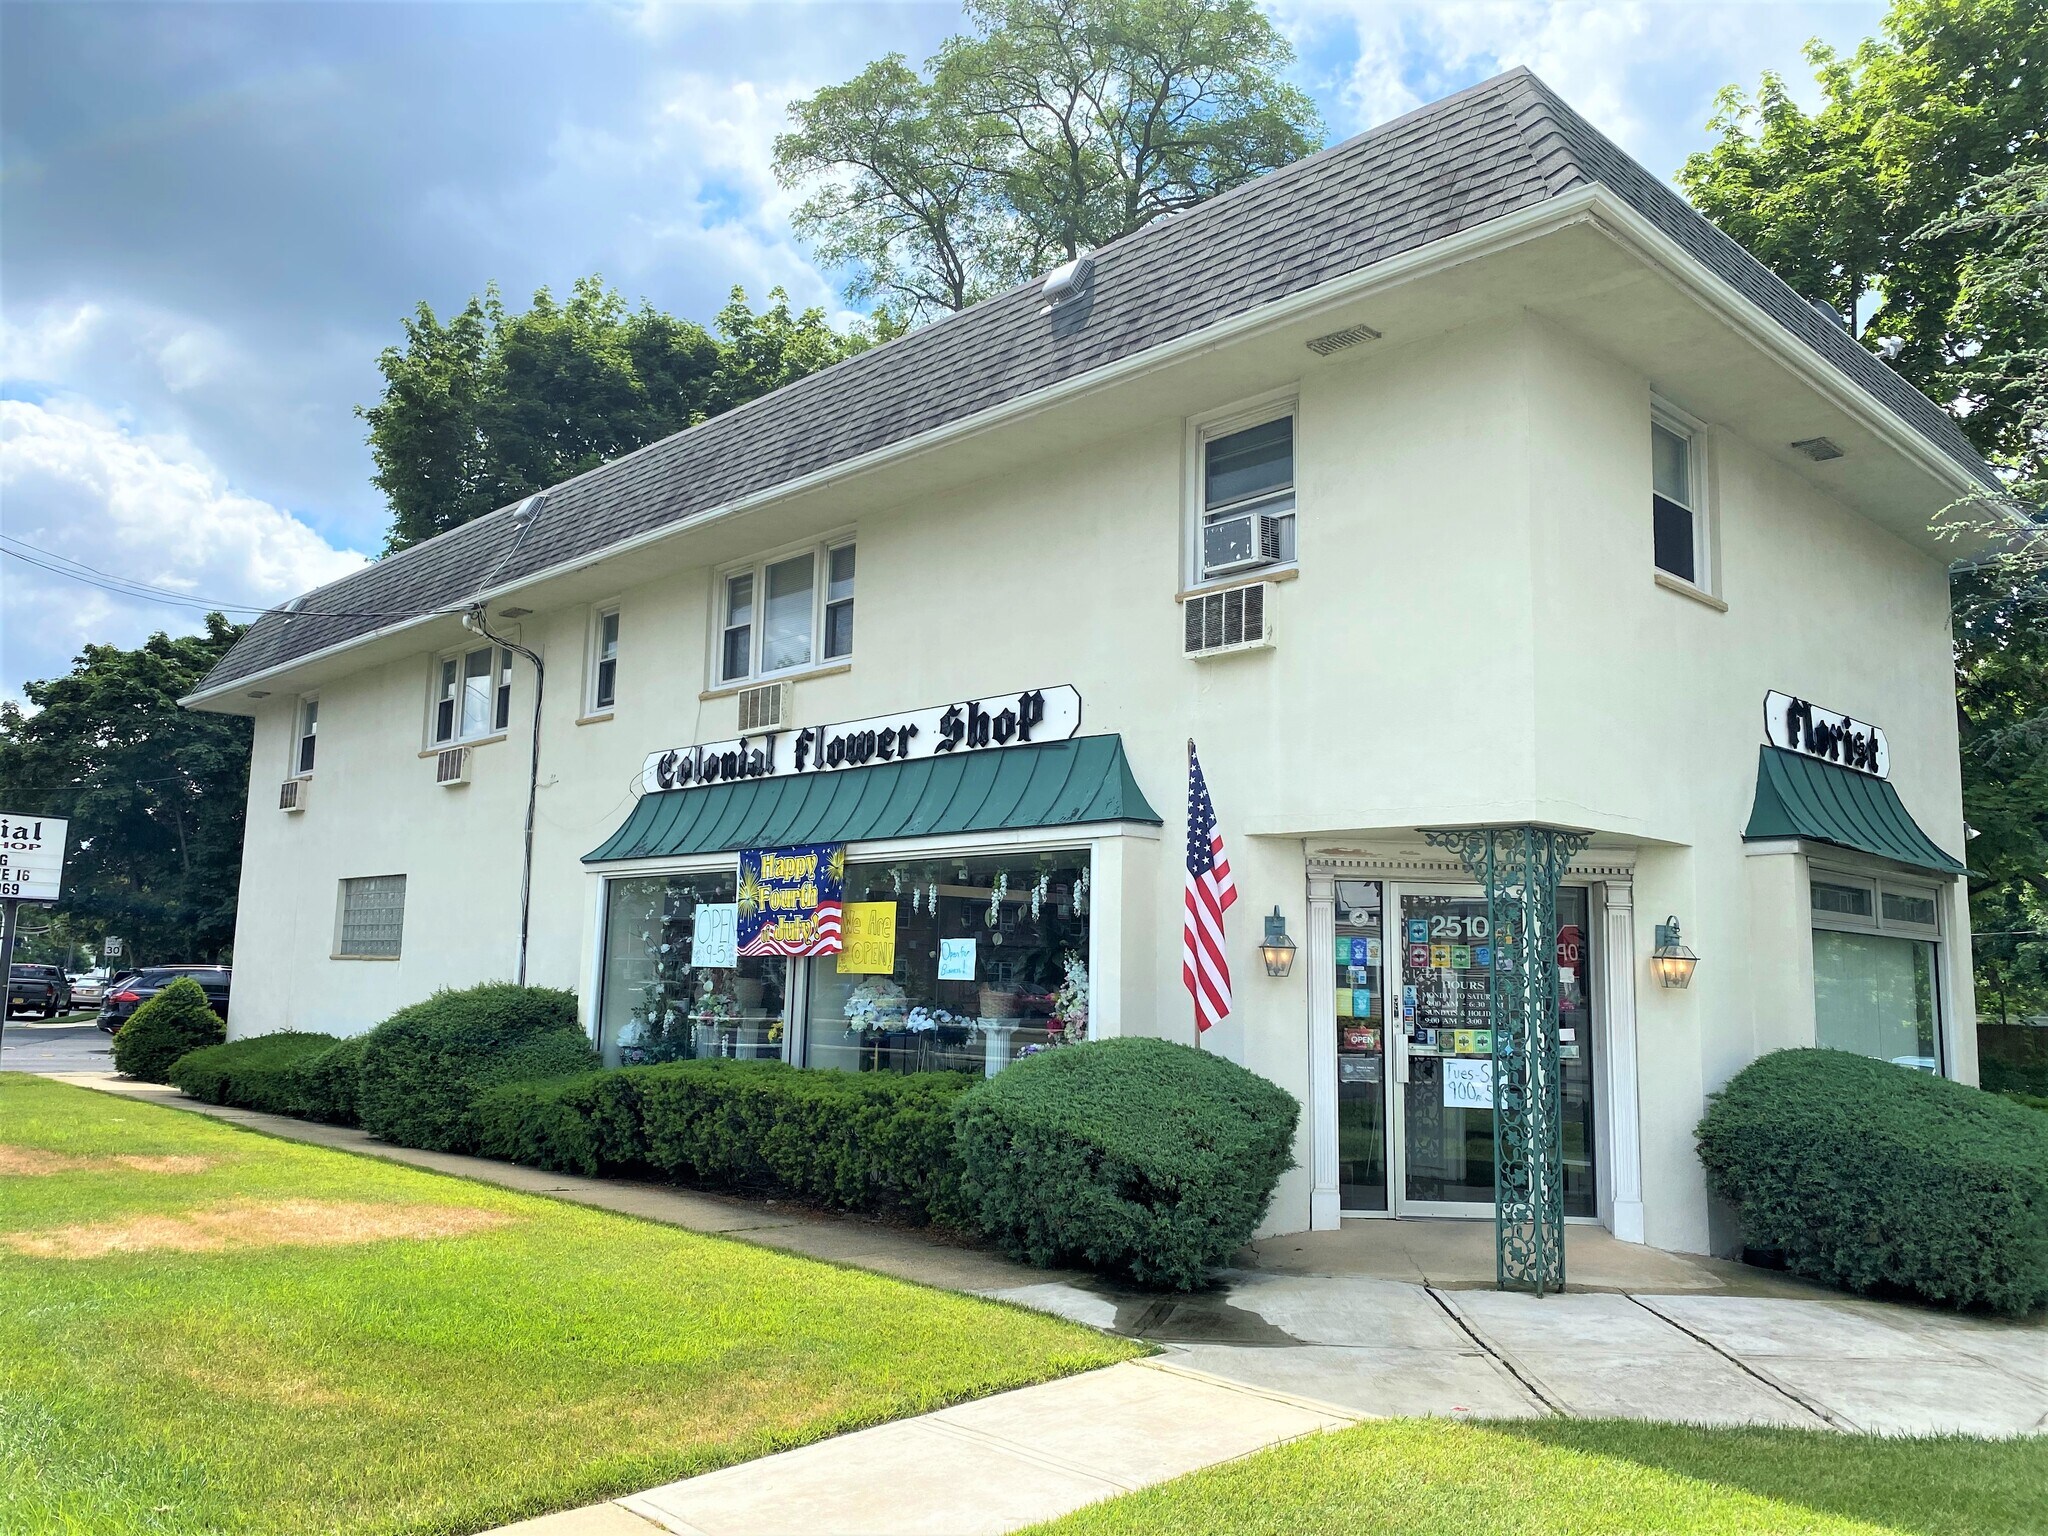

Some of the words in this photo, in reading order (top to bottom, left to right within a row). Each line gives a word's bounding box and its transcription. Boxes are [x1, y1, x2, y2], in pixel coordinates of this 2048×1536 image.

[1787, 696, 1879, 774] Florist
[657, 734, 776, 790] Colonial
[794, 722, 919, 772] Flower
[0, 818, 42, 841] ial
[0, 868, 10, 880] E
[17, 869, 30, 882] 16
[760, 852, 818, 883] Happy
[0, 882, 20, 896] 69
[758, 881, 818, 913] Fourth
[774, 912, 820, 946] July!
[843, 909, 861, 935] We
[868, 909, 892, 939] Are
[1430, 915, 1490, 938] 2510
[106, 946, 120, 955] 30
[707, 944, 726, 964] 9-5
[851, 941, 894, 972] OPEN!
[1442, 980, 1485, 990] HOURS
[1351, 1035, 1374, 1045] OPEN
[1445, 1061, 1494, 1083] Tues-S
